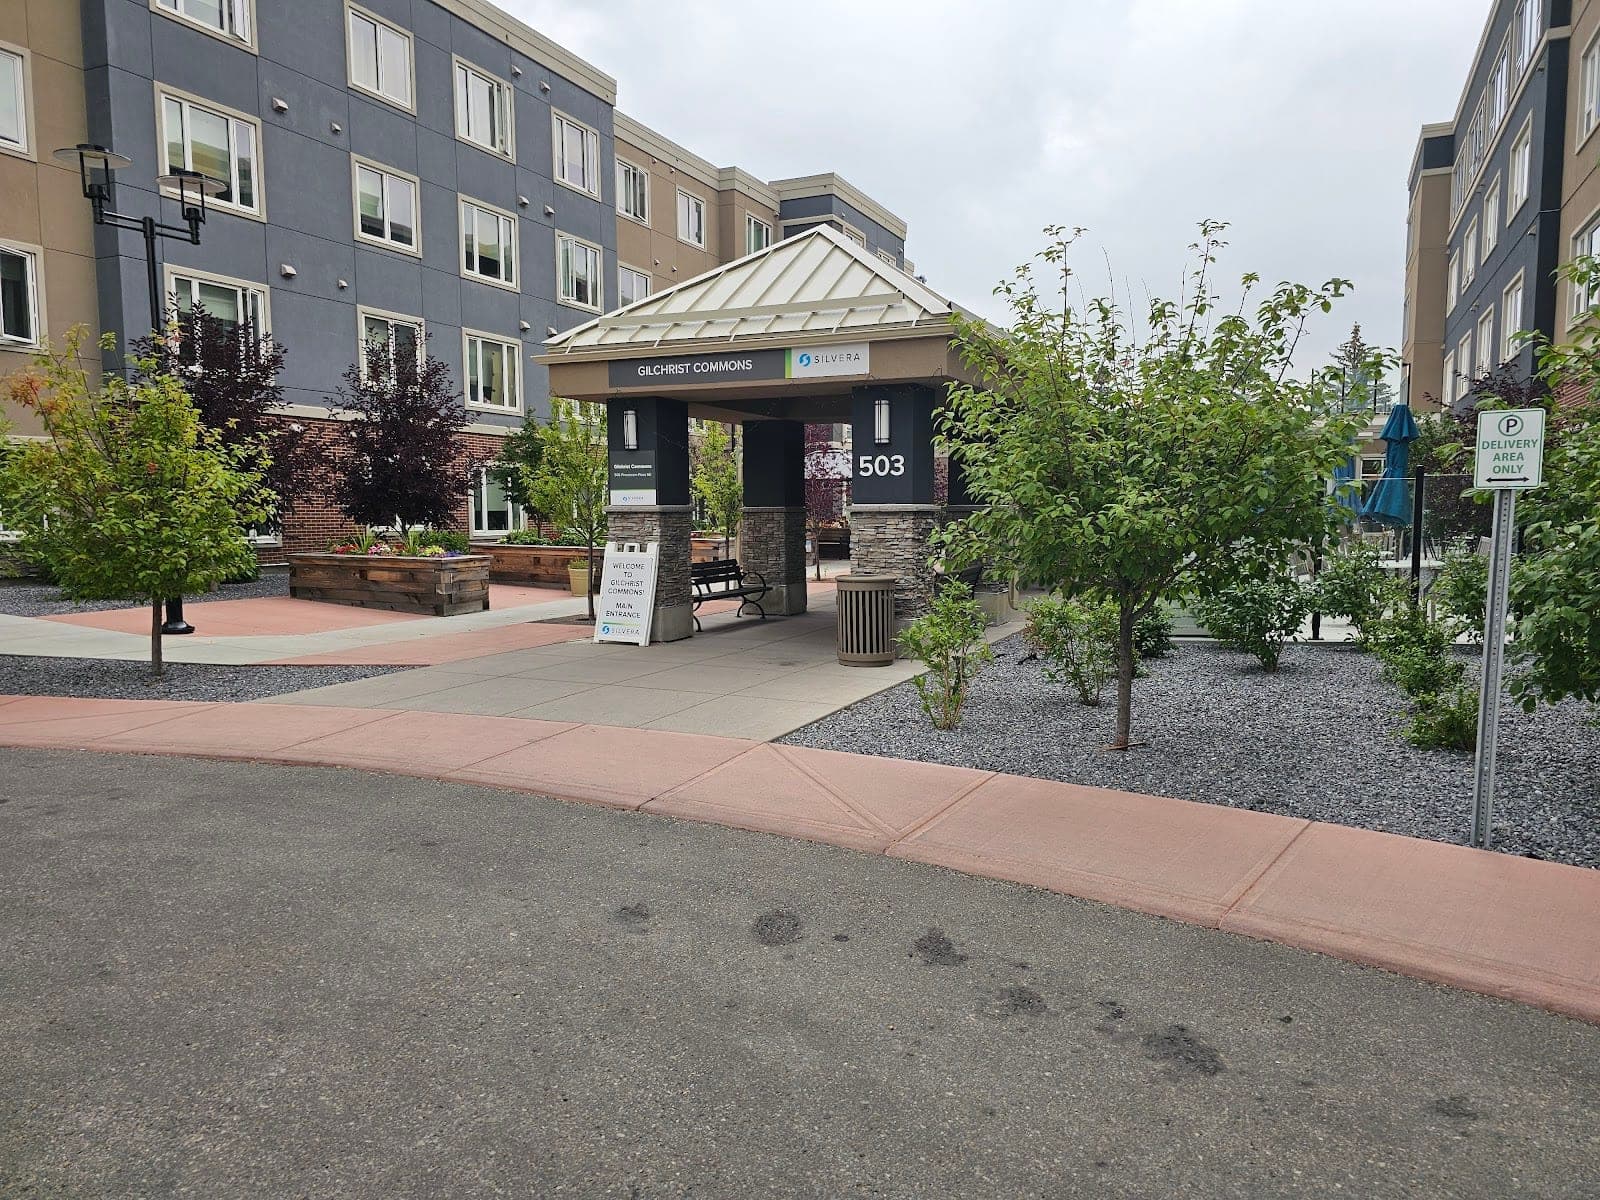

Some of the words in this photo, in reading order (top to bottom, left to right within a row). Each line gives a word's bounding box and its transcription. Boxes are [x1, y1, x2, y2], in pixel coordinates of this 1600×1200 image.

[814, 353, 861, 364] SILVERA
[637, 362, 691, 376] GILCHRIST
[693, 359, 753, 374] COMMONS
[1506, 418, 1518, 433] P
[1481, 438, 1538, 450] DELIVERY
[1492, 452, 1525, 462] AREA
[859, 454, 905, 477] 503
[1492, 464, 1524, 474] ONLY
[612, 562, 646, 570] WELCOME
[615, 602, 633, 610] MAIN
[605, 610, 641, 619] ENTRANCE
[611, 627, 640, 636] SILVERA
